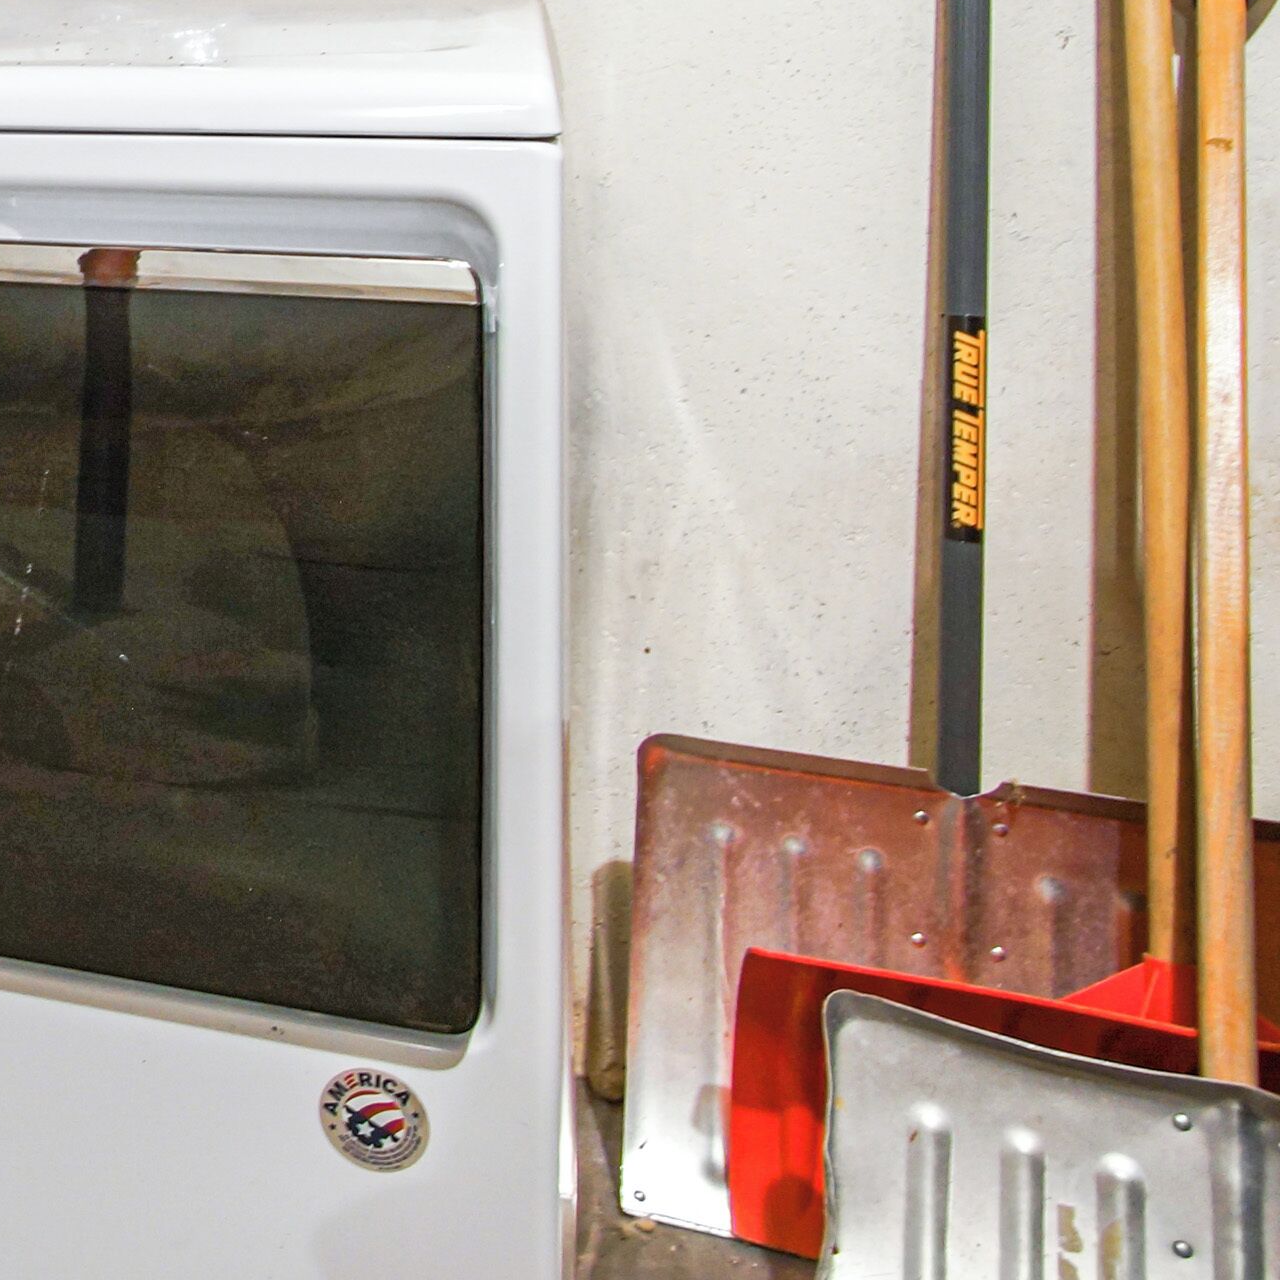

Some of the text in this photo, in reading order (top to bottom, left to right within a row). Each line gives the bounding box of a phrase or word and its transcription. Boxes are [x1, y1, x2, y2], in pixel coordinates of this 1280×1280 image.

[951, 329, 986, 530] TRUE TEMPER
[323, 1072, 411, 1116] AMERICA
